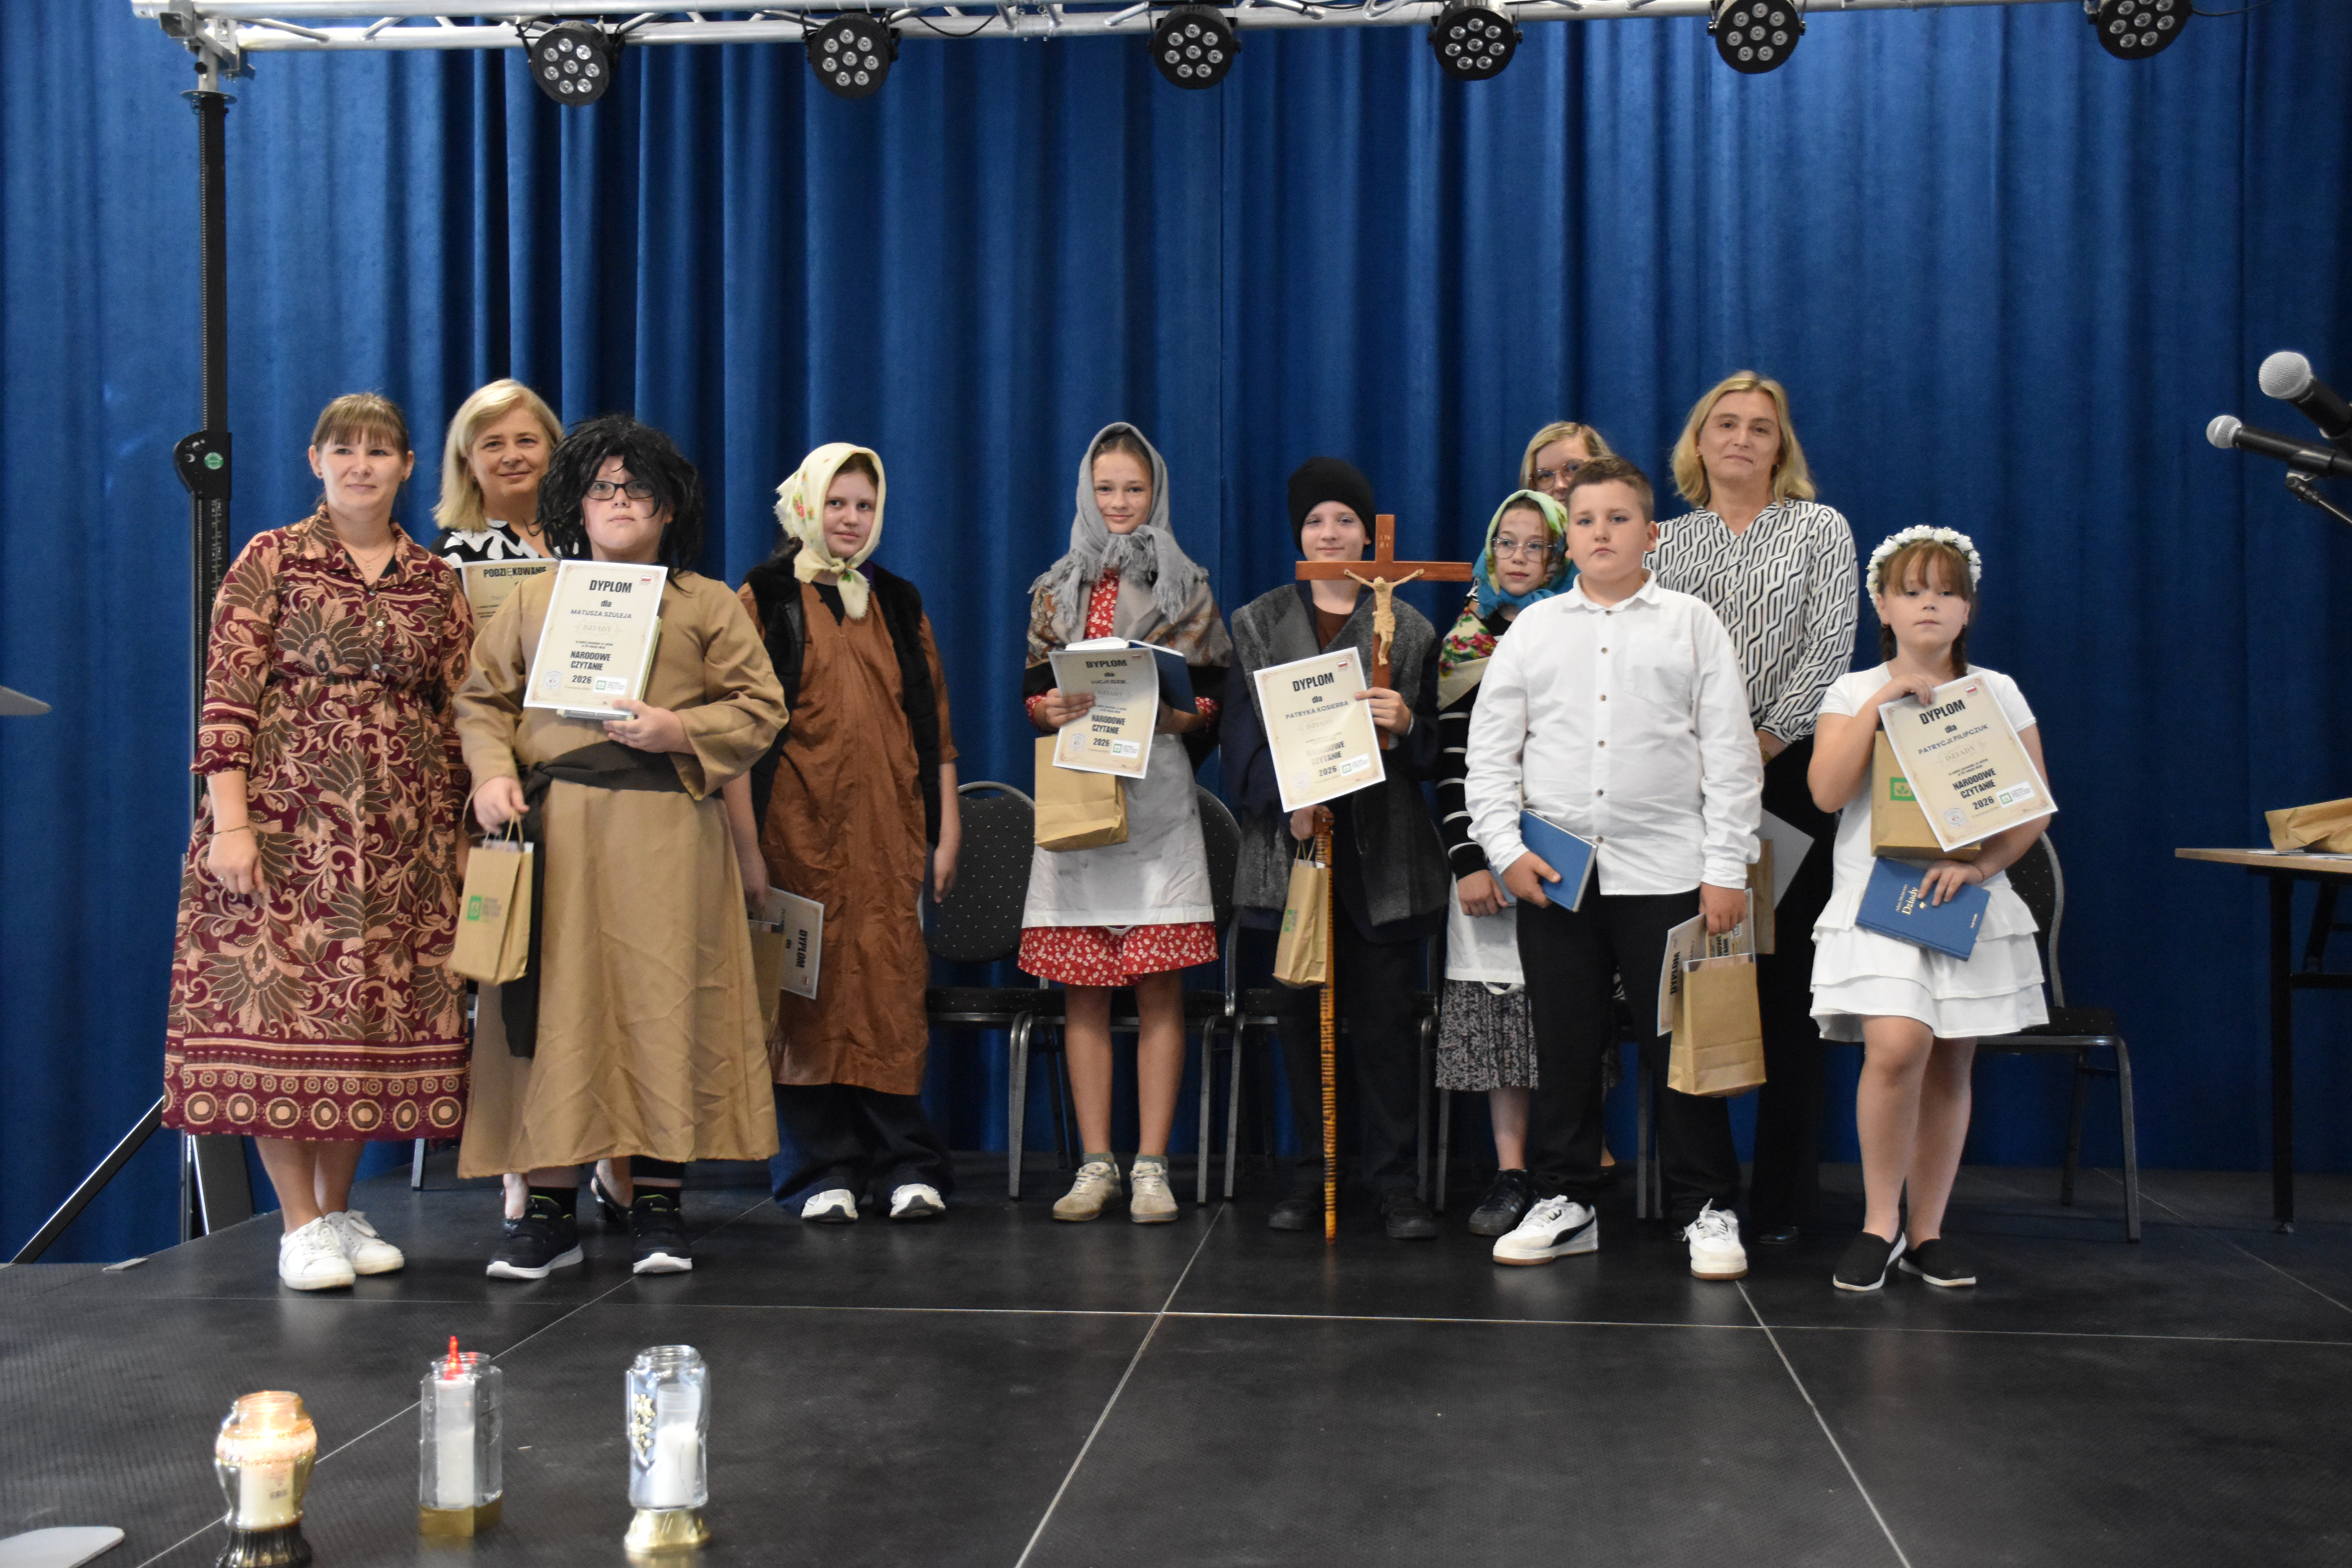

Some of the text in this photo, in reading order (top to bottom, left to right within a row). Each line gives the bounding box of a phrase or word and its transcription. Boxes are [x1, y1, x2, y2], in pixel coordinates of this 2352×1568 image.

[589, 580, 632, 593] DYPLOM
[570, 651, 611, 661] NARODOWE
[570, 661, 604, 670] CZYTANIE
[1085, 660, 1127, 668] DYPLOM
[572, 675, 592, 684] 2026
[1292, 672, 1334, 691] DYPLOM
[1285, 709, 1316, 719] PATRYKA
[1919, 699, 1965, 724] DYPLOM
[1091, 714, 1125, 725] NARODOWE
[1092, 724, 1119, 734] CZYTANIE
[1945, 724, 1957, 733] dla
[1093, 738, 1110, 747] 2026
[1918, 724, 1988, 754] PATRYCJI PILIPCZUK
[1945, 746, 1975, 761] DZIADY
[1318, 766, 1337, 777] 2026
[1952, 768, 1996, 791] NARODOWE
[1960, 779, 1996, 799] CZYTANIE
[1972, 796, 1994, 809] 2026
[1901, 887, 1919, 915] Dziady
[796, 929, 808, 968] DYPLOM
